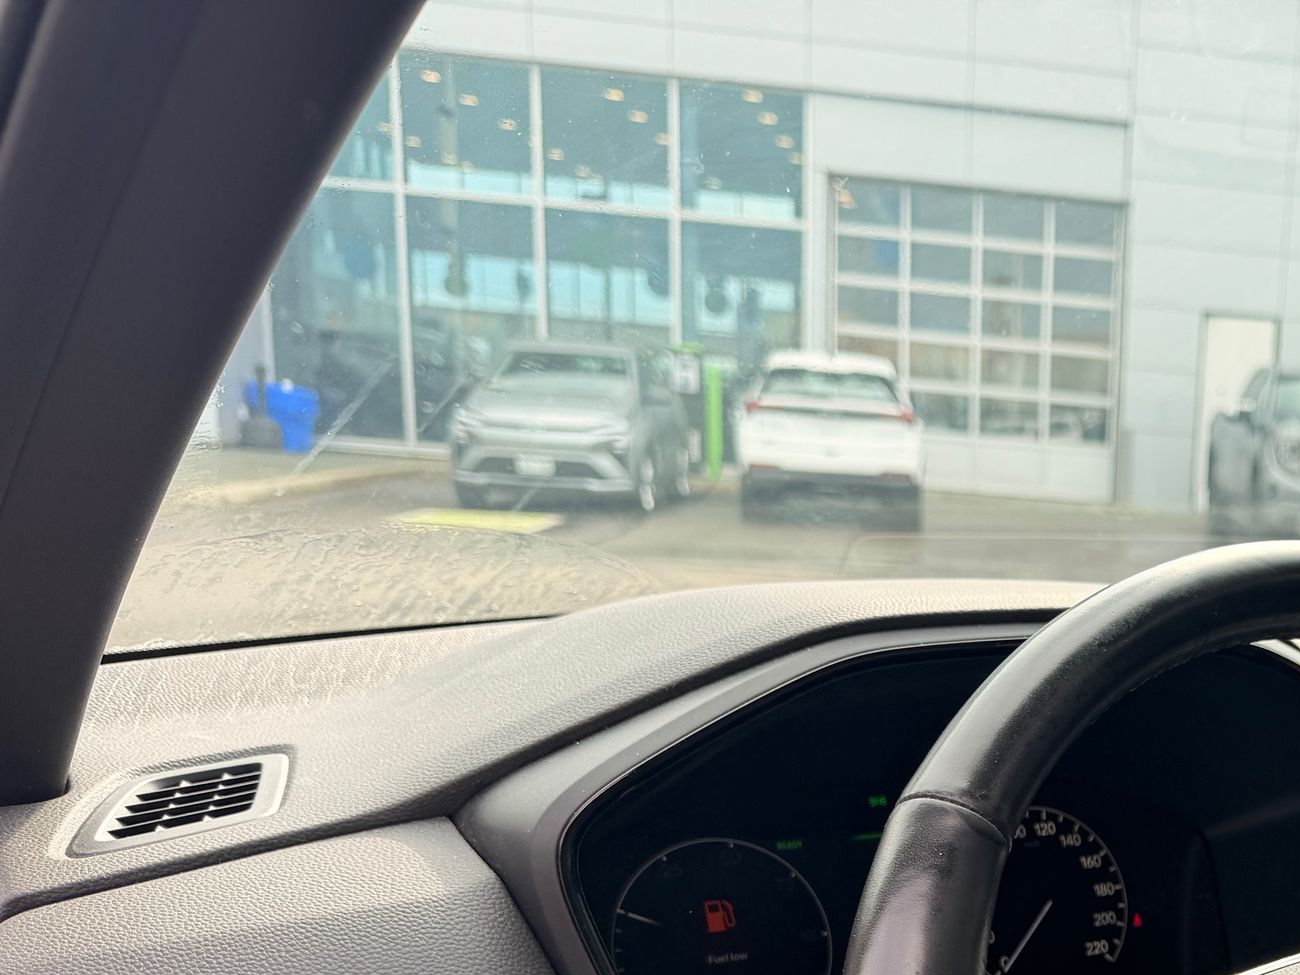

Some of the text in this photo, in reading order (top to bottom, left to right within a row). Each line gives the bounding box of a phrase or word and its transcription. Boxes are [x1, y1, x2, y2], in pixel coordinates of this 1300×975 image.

[1034, 820, 1056, 837] 120
[1059, 833, 1082, 848] 140
[1079, 854, 1102, 870] 160
[1094, 882, 1115, 897] 180
[1092, 911, 1117, 927] 200
[1084, 938, 1109, 956] 220
